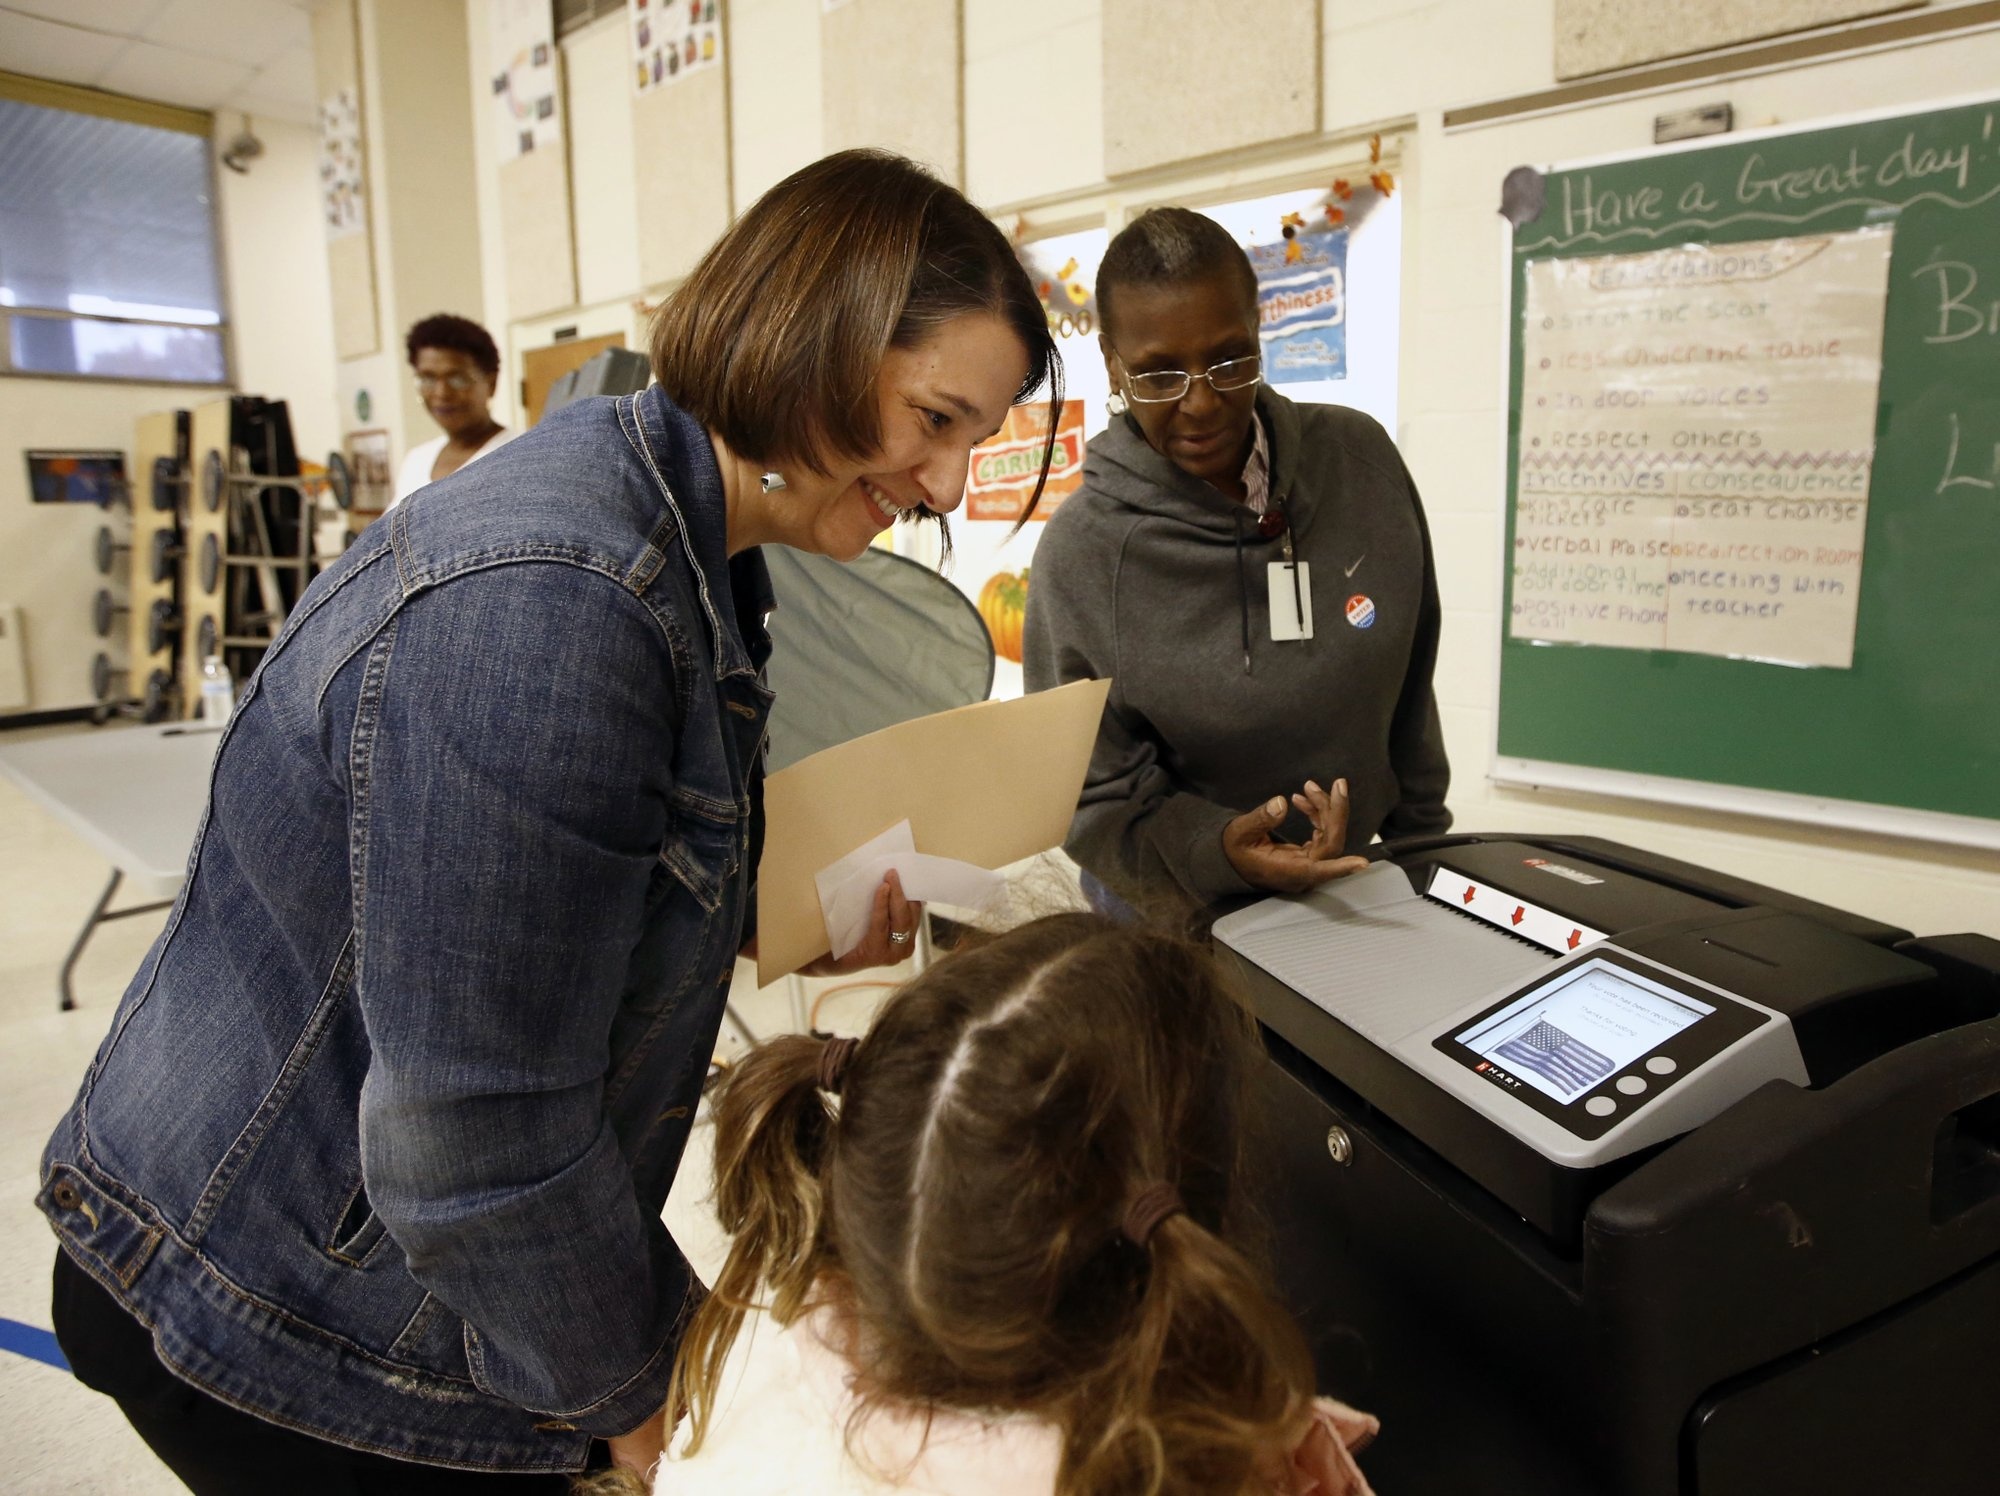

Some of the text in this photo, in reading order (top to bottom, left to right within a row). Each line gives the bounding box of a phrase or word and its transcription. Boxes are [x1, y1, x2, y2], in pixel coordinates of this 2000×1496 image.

[1562, 174, 1664, 236] Have
[1677, 181, 1719, 214] a
[1736, 152, 1870, 203] Great
[1258, 282, 1335, 324] rthiness
[1524, 471, 1665, 490] Incentives
[1604, 989, 1619, 999] vote
[1487, 1065, 1523, 1089] HART
